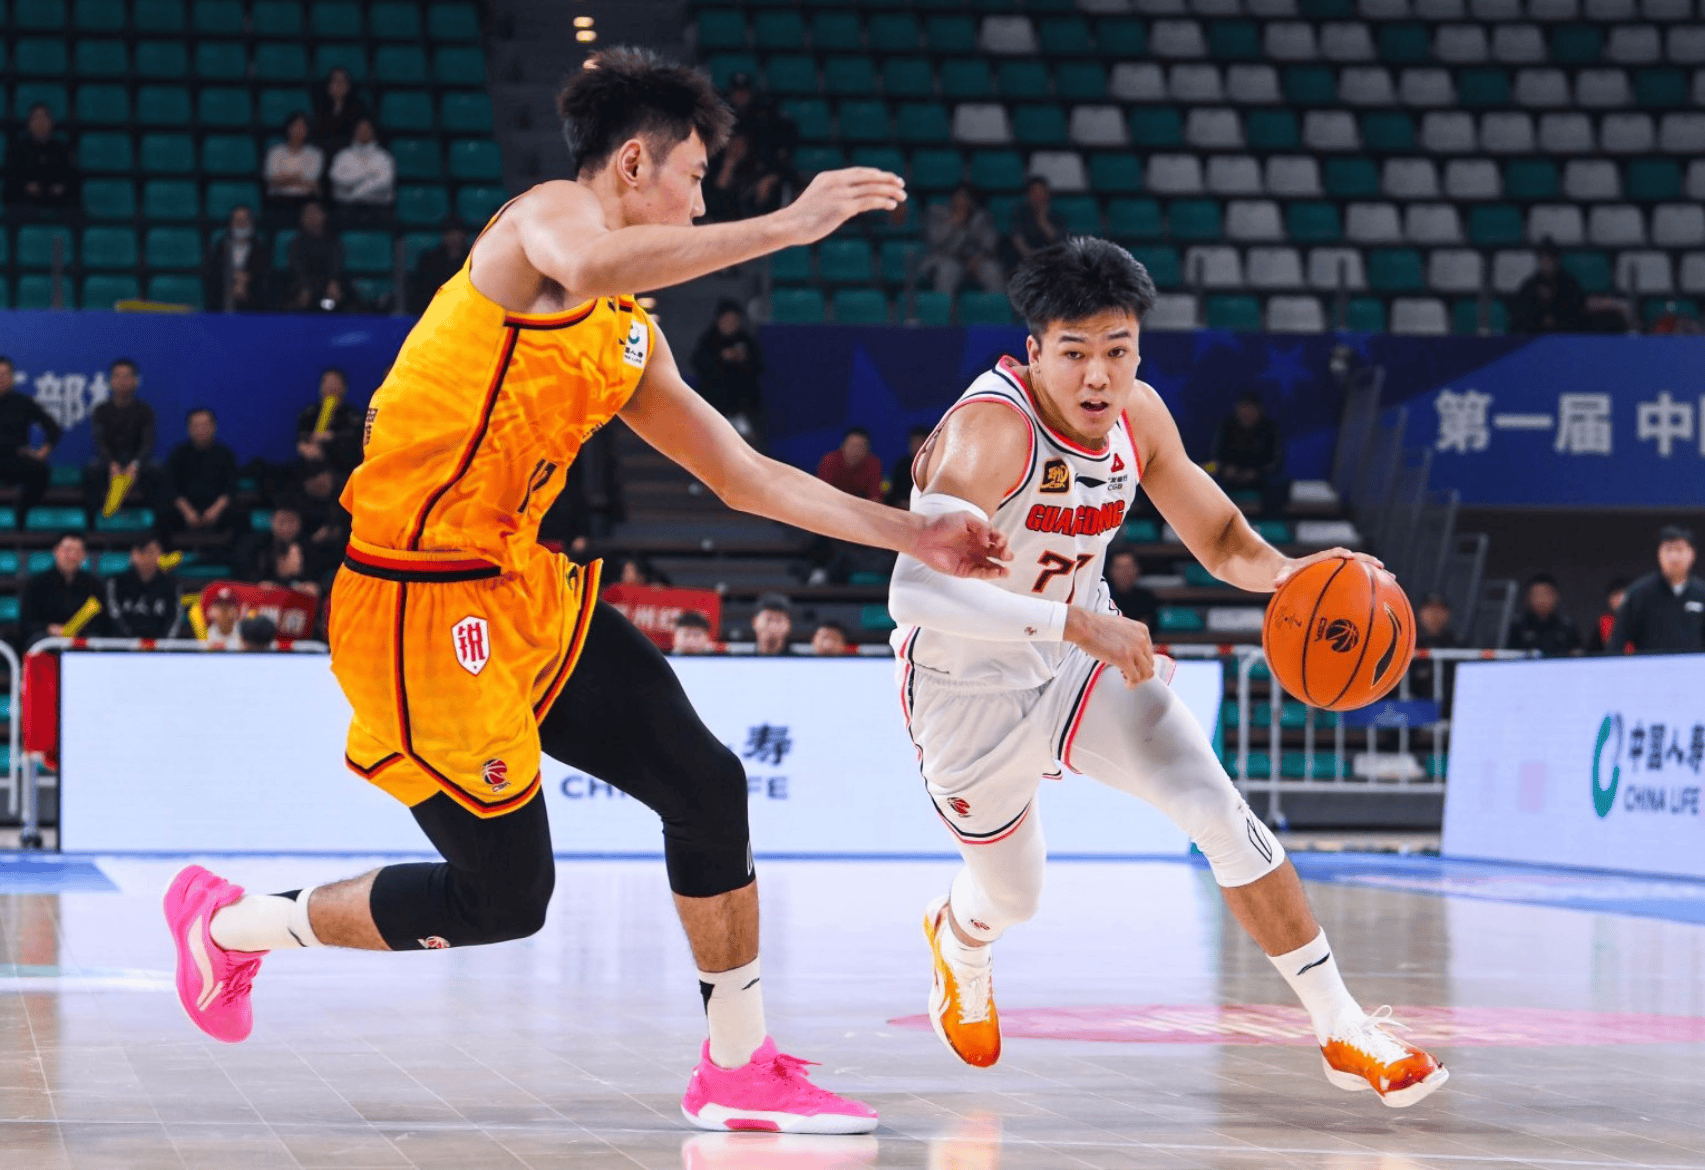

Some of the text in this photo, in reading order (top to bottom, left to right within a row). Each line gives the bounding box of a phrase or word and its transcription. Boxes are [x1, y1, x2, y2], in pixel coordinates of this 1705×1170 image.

[1435, 388, 1705, 458] 第一届 中
